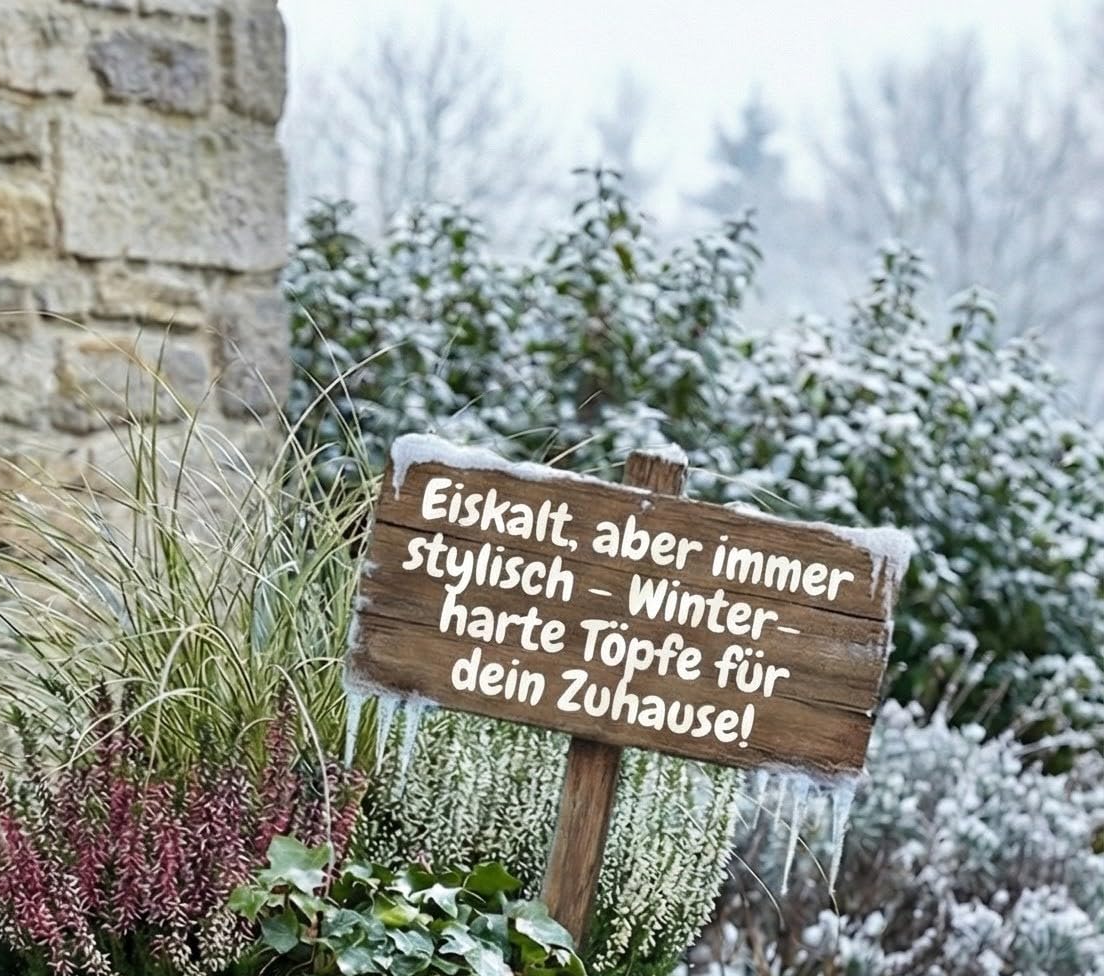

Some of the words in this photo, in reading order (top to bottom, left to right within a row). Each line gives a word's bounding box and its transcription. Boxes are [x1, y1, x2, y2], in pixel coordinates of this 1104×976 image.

[402, 533, 574, 601] stylisch
[629, 573, 801, 636] Winter-
[421, 477, 578, 551] Eiskalt,
[592, 514, 703, 570] aber
[712, 535, 855, 600] immer
[440, 585, 565, 654] harte
[580, 618, 702, 682] Töpfe
[714, 644, 790, 698] für
[451, 648, 545, 705] dein
[557, 668, 756, 748] Zuhause!
